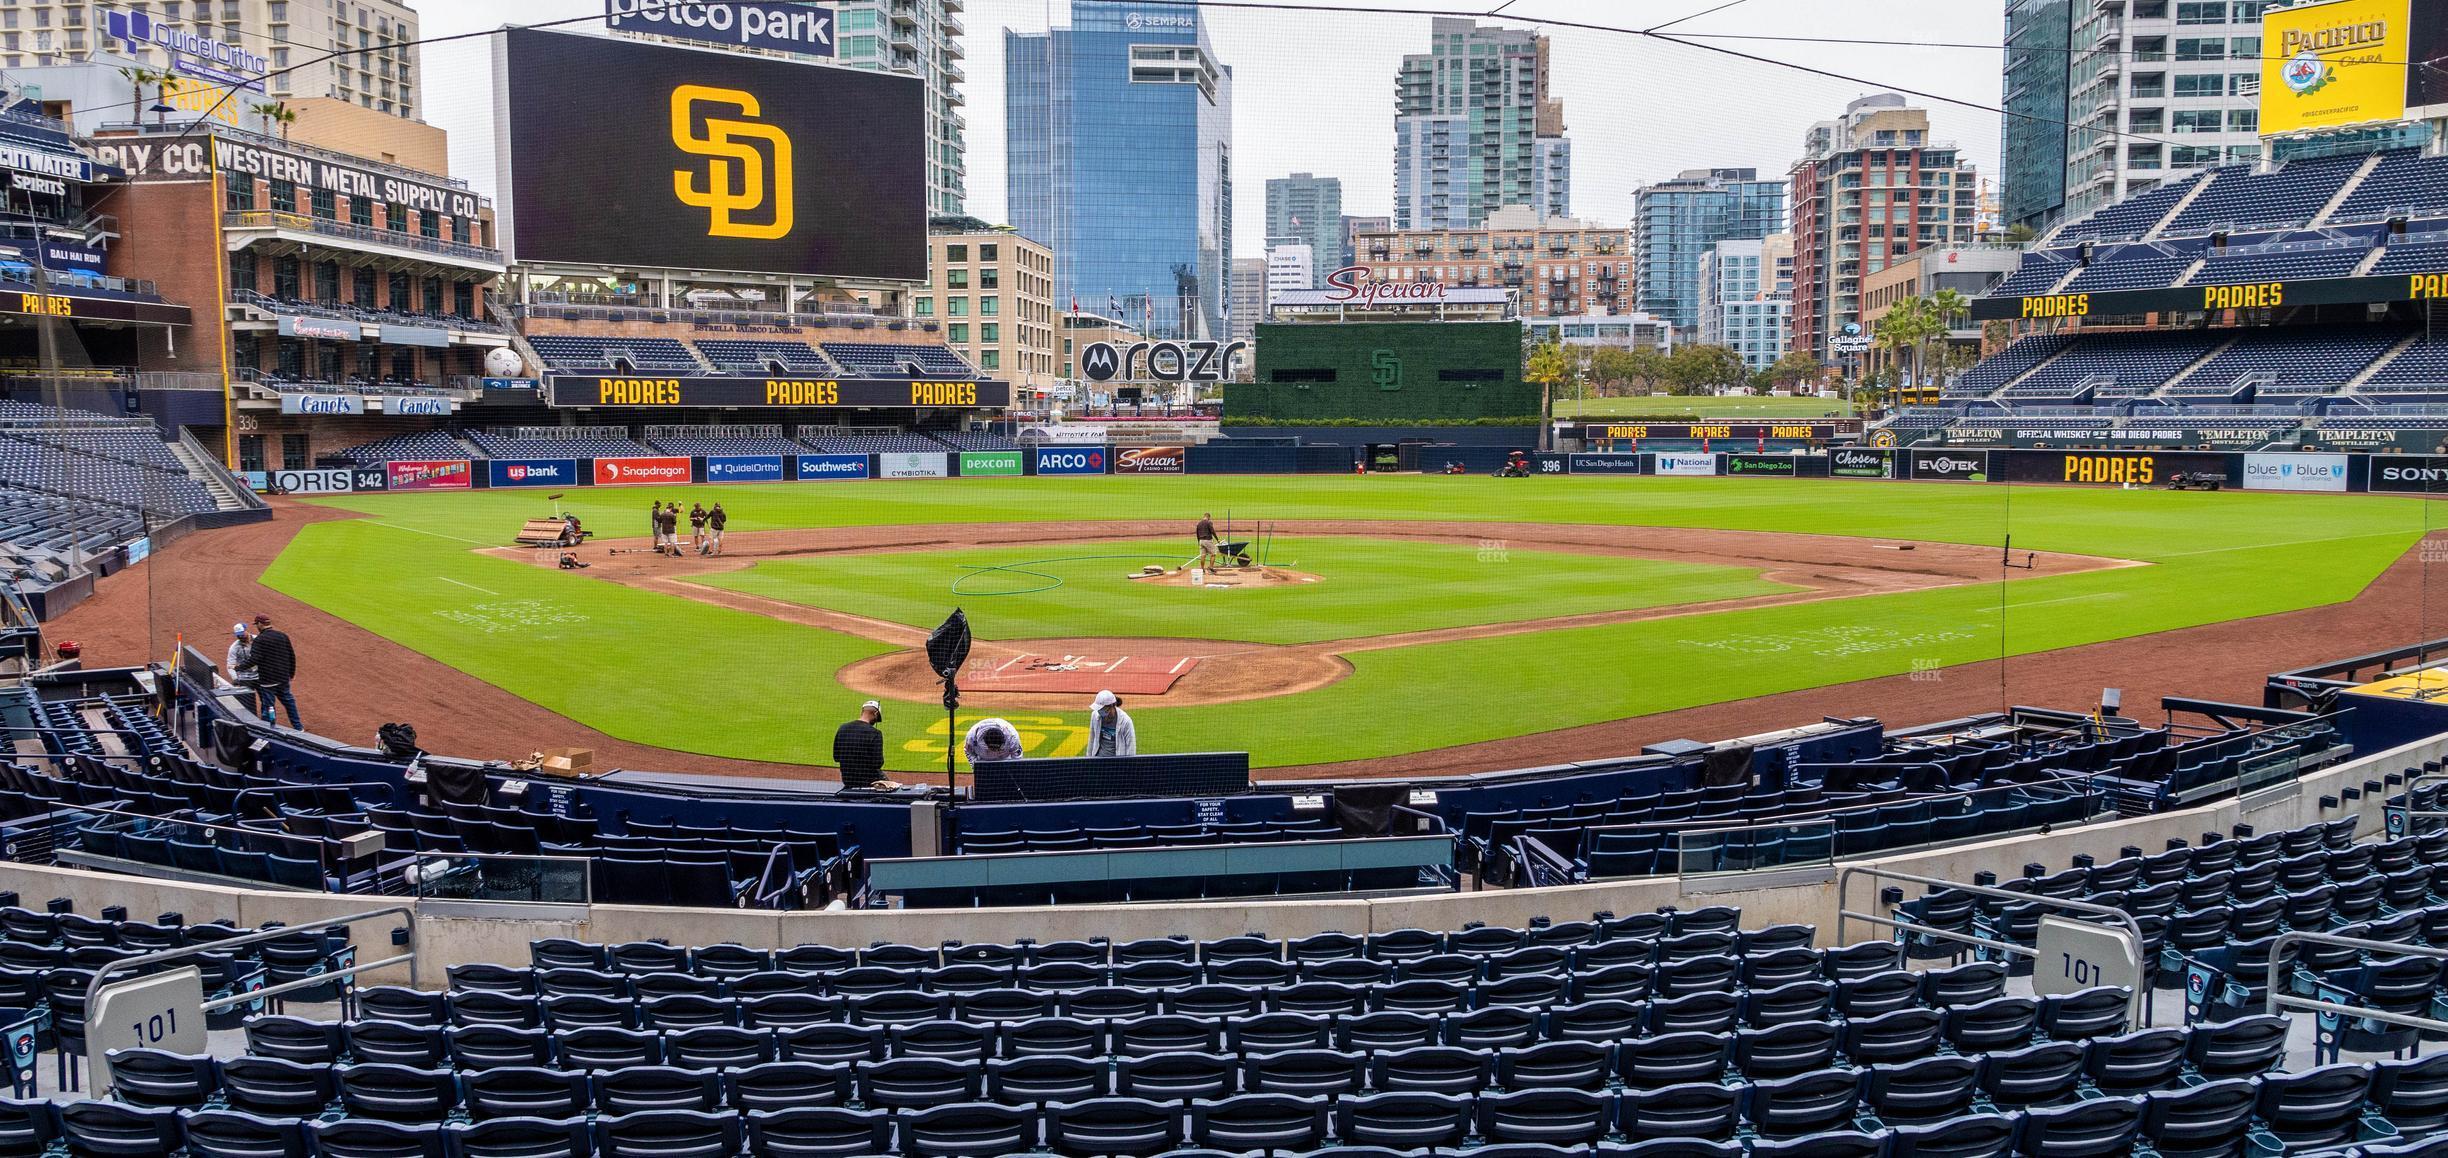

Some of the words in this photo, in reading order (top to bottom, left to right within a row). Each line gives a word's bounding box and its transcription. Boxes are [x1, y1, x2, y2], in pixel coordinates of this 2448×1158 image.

[611, 0, 733, 31] petco
[741, 6, 831, 45] park
[1145, 17, 1194, 27] SEMPRA
[2281, 20, 2387, 57] PACIFICO
[155, 22, 265, 75] QuidelOrtho
[2339, 53, 2383, 68] CLARA
[163, 78, 239, 127] PADRES
[0, 149, 83, 179] CUTWATER
[163, 142, 212, 174] CO.
[12, 173, 66, 196] SPIRITS
[214, 139, 312, 186] WESTERN
[321, 164, 381, 200] METAL
[385, 179, 447, 213] SUPPLY
[453, 194, 478, 219] CO.
[51, 248, 68, 260] BALI
[70, 251, 83, 262] HAI
[84, 252, 101, 264] RUM
[1325, 265, 1448, 311] Sycuan
[2205, 283, 2282, 310] PADRES
[2022, 294, 2088, 318] PADRES
[694, 325, 734, 333] ESTRELLA
[1828, 336, 1874, 345] Gallagher
[1834, 344, 1868, 353] Square
[1125, 341, 1248, 381] razr
[600, 379, 680, 404] PADRES
[766, 381, 839, 405] PADRES
[911, 382, 976, 405] PADRES
[300, 395, 351, 414] Canel's
[399, 397, 441, 415] Canel's
[239, 415, 258, 430] 336
[1608, 426, 1647, 438] PADRES
[1772, 426, 1813, 438] PADRES
[1946, 429, 2003, 439] TEMPLETON
[2017, 431, 2052, 439] OFFICIAL
[2054, 431, 2091, 439] WHISKEY
[2111, 431, 2126, 439] SAN
[2128, 431, 2150, 439] DIEGO
[2152, 431, 2183, 439] PADRES
[2197, 430, 2269, 440] TEMPLETON
[2317, 430, 2396, 441] TEMPLETON
[1040, 454, 1087, 468] ARCO
[1119, 449, 1178, 471] Sycuan
[1598, 460, 1614, 469] Diego
[1677, 458, 1712, 466] National
[1835, 450, 1879, 464] Chosen
[510, 468, 525, 477] us
[527, 466, 559, 477] bank
[623, 465, 685, 478] Snapdragon
[725, 463, 779, 474] QuidelOrtho
[802, 462, 857, 473] Southwest
[1542, 461, 1561, 472] 396
[1759, 462, 1778, 470] Diego
[1918, 457, 1978, 474] EVOTEK
[2064, 455, 2154, 483] PADRES
[2248, 463, 2278, 475] blue
[2296, 463, 2328, 476] blue
[280, 472, 350, 491] ORIS
[358, 473, 383, 488] 342
[2297, 680, 2318, 689] bank
[2062, 952, 2101, 987] 101
[133, 1007, 177, 1047] 101
